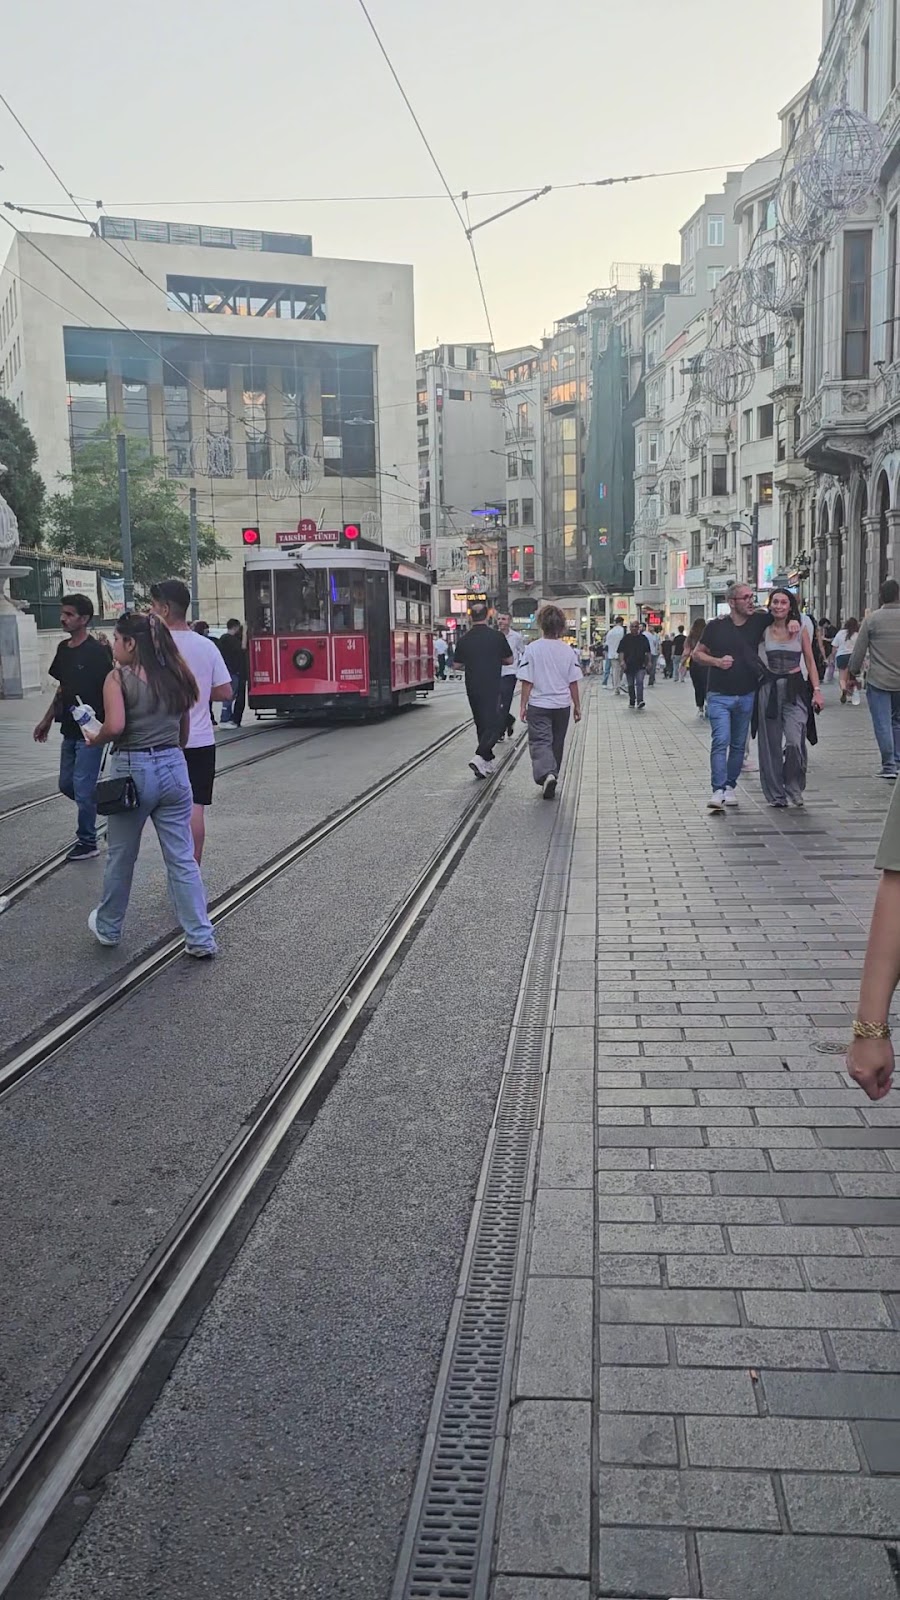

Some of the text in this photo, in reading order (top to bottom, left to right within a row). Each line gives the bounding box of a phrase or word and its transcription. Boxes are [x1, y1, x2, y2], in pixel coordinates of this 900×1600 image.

[279, 533, 306, 542] TAKSİM
[314, 532, 337, 541] TÜNEL
[347, 639, 356, 650] 34
